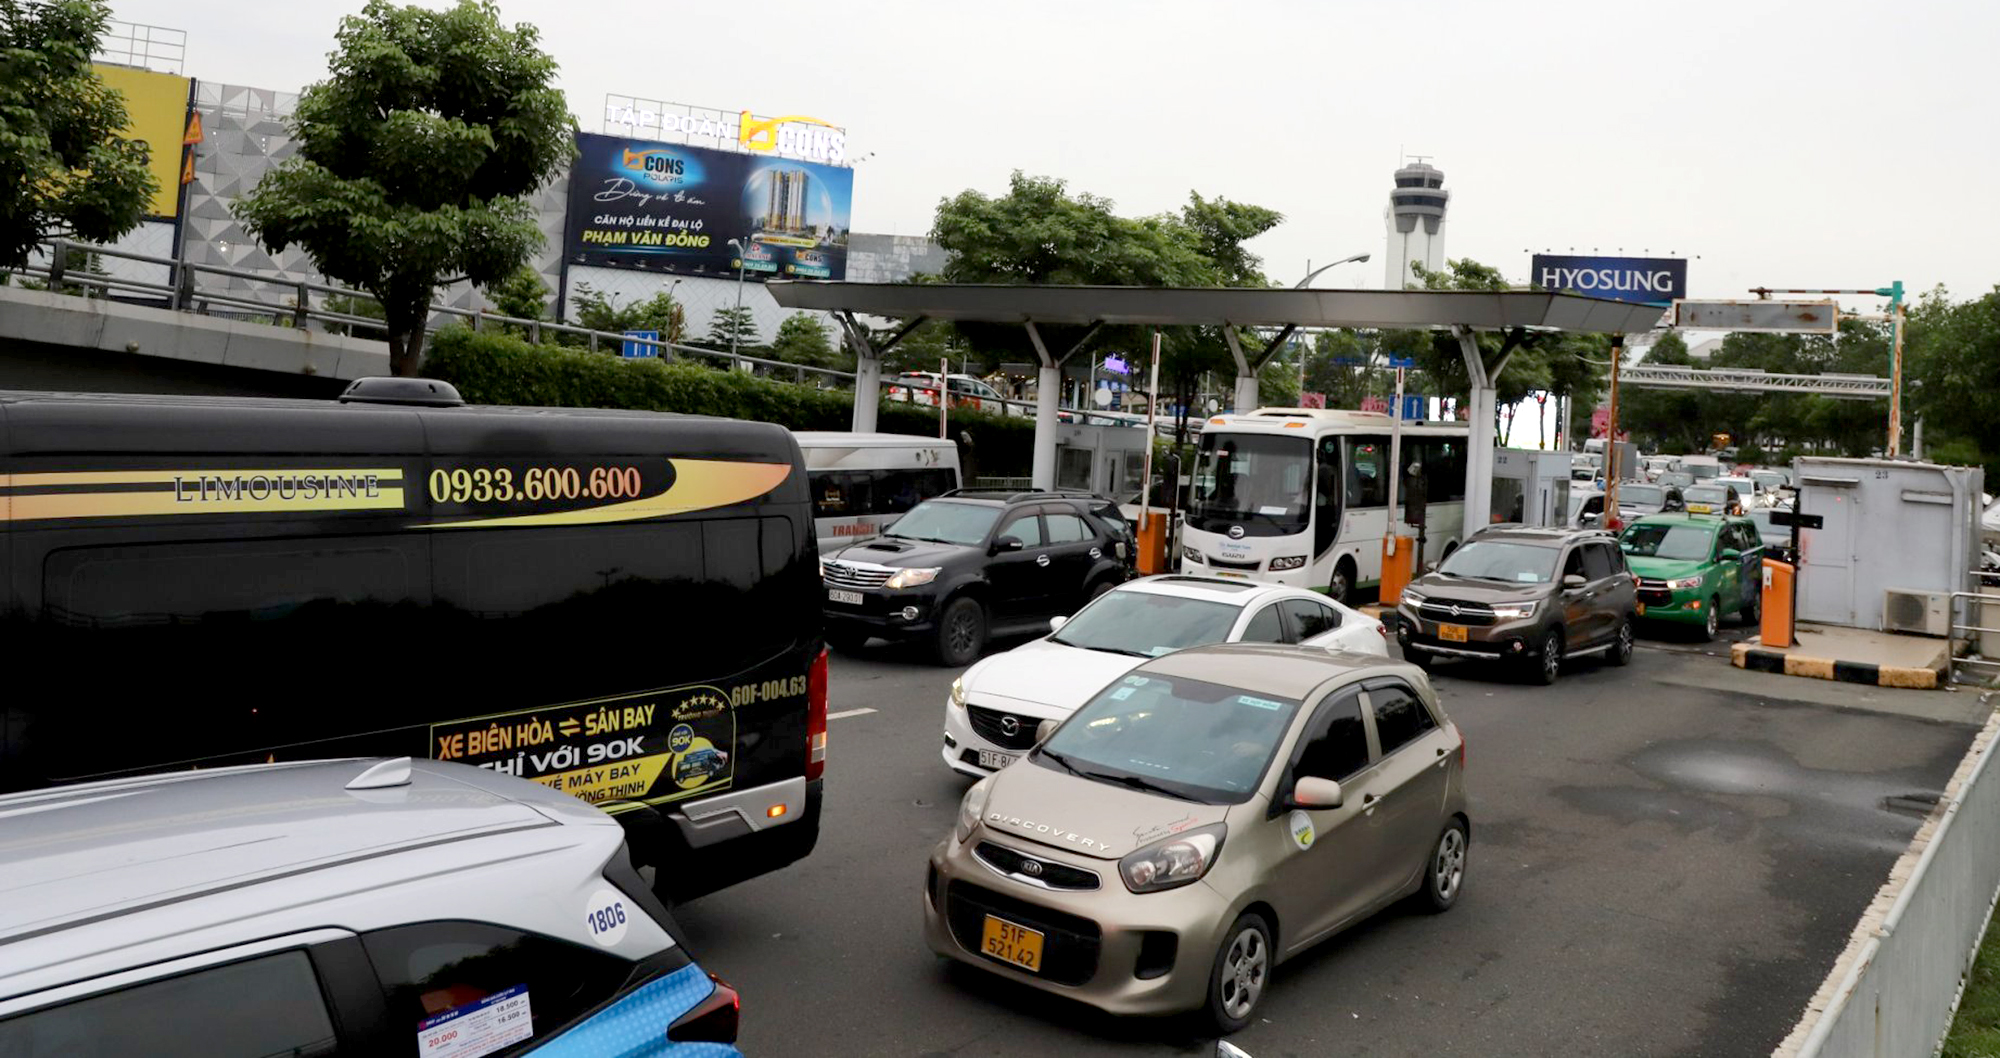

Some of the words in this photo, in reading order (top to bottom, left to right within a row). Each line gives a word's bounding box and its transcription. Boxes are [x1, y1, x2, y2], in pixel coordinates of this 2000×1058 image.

[606, 103, 656, 130] TẬP
[661, 113, 732, 139] ĐOÀN
[594, 214, 617, 225] CĂN
[618, 215, 635, 228] HỘ
[671, 219, 689, 231] ĐẠI
[690, 219, 704, 231] LỘ
[582, 230, 628, 247] PHẠM
[631, 230, 663, 246] VĂN
[665, 229, 710, 248] ĐỒNG
[1542, 267, 1673, 292] HYOSUNG
[1497, 456, 1508, 464] 22
[429, 467, 642, 504] 0933.600.600
[1875, 470, 1889, 480] 23
[173, 474, 380, 502] LIMOUSINE
[832, 522, 876, 537] TRANSIT
[731, 675, 807, 707] 60F-004.63
[438, 733, 464, 760] XE
[468, 723, 512, 757] BIÊN
[517, 716, 555, 748] HÒA
[585, 708, 620, 736] SÂN
[623, 704, 656, 730] BAY
[530, 745, 580, 772] VỚI
[587, 735, 645, 763] 90K
[568, 769, 603, 789] MÁY
[609, 764, 642, 780] BAY
[609, 780, 645, 798] THỊNH
[990, 812, 1111, 851] DISCOVERY
[1021, 861, 1039, 874] KIA
[588, 902, 627, 935] 1806
[1001, 923, 1026, 945] 51F
[989, 937, 1035, 967] 521.42
[428, 1030, 458, 1047] 20.000
